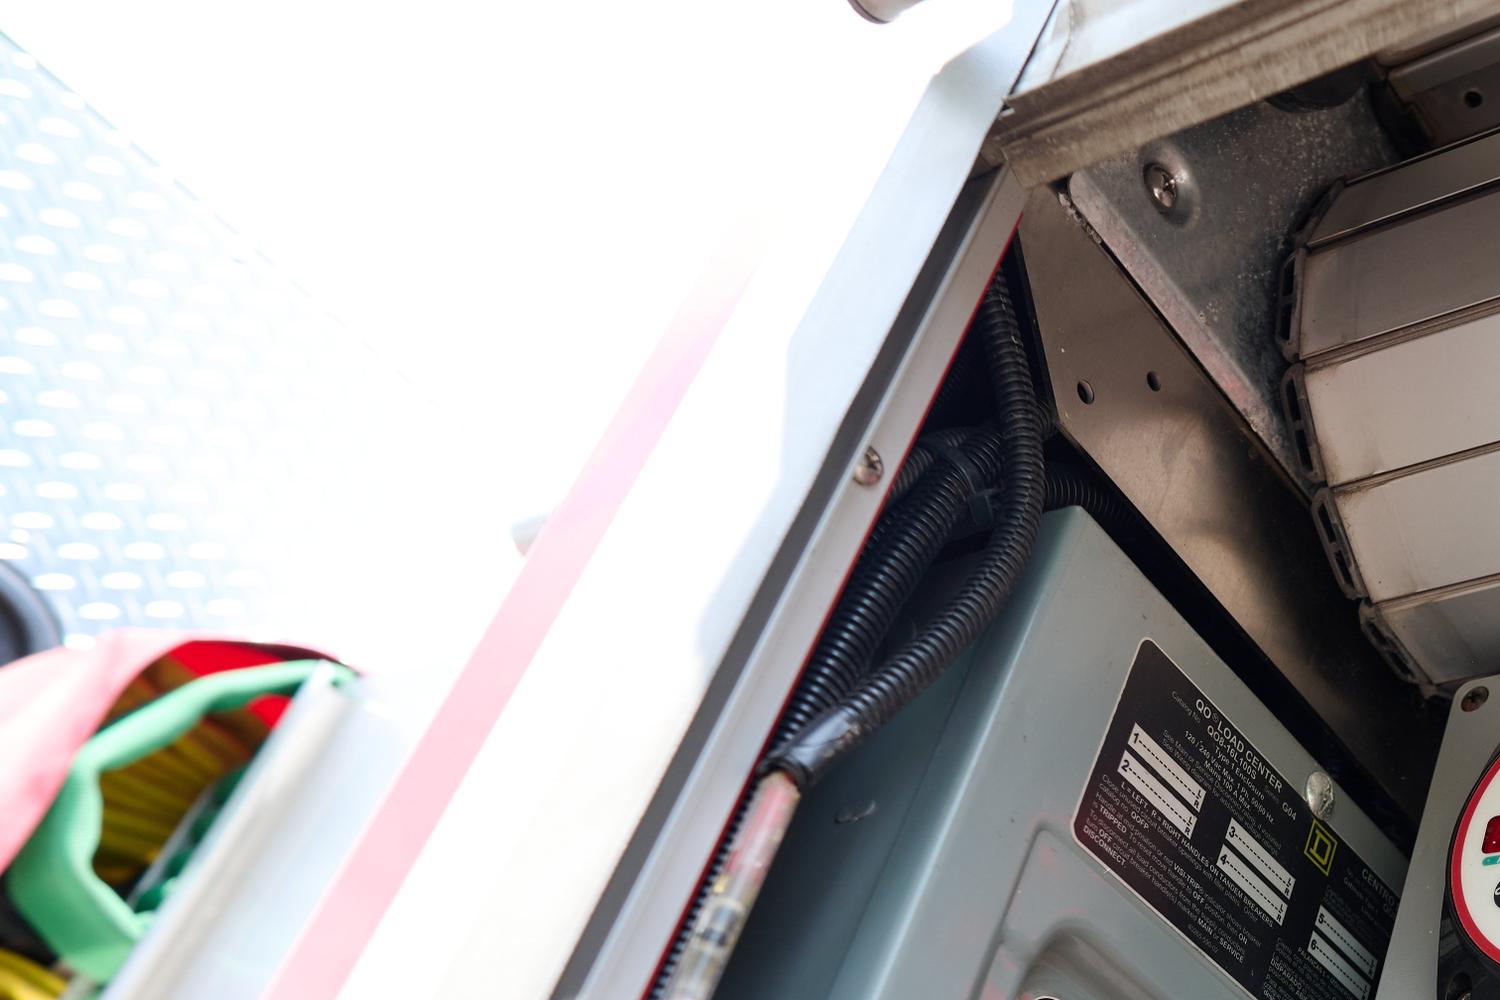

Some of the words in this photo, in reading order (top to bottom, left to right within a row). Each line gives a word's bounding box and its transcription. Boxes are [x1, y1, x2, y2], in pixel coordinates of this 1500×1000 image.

[1133, 732, 1140, 745] 1
[1183, 728, 1196, 746] 120
[1198, 743, 1211, 761] 240
[1209, 755, 1222, 772] Vac
[1121, 759, 1130, 773] 2
[1216, 719, 1245, 755] LOAD
[1244, 747, 1283, 794] CENTER
[1203, 759, 1222, 782] Mains
[1221, 777, 1233, 793] 100
[1232, 787, 1239, 799] A
[1213, 744, 1230, 767] Type
[1234, 766, 1265, 802] Enclosure
[1281, 800, 1297, 822] G04
[1229, 826, 1236, 838] 3
[1161, 819, 1181, 842] RIGHT
[1180, 836, 1209, 868] HANDLES
[1208, 863, 1220, 878] ON
[1219, 872, 1244, 900] TANDEM
[1242, 894, 1274, 928] BREAKERS
[1220, 854, 1227, 866] 4
[1097, 827, 1112, 845] OFF
[1197, 916, 1213, 936] MAIN
[1218, 935, 1244, 963] SERVICE
[1191, 889, 1205, 906] OFF
[1238, 930, 1248, 944] ON
[1318, 913, 1325, 925] 5
[1311, 939, 1318, 951] 6
